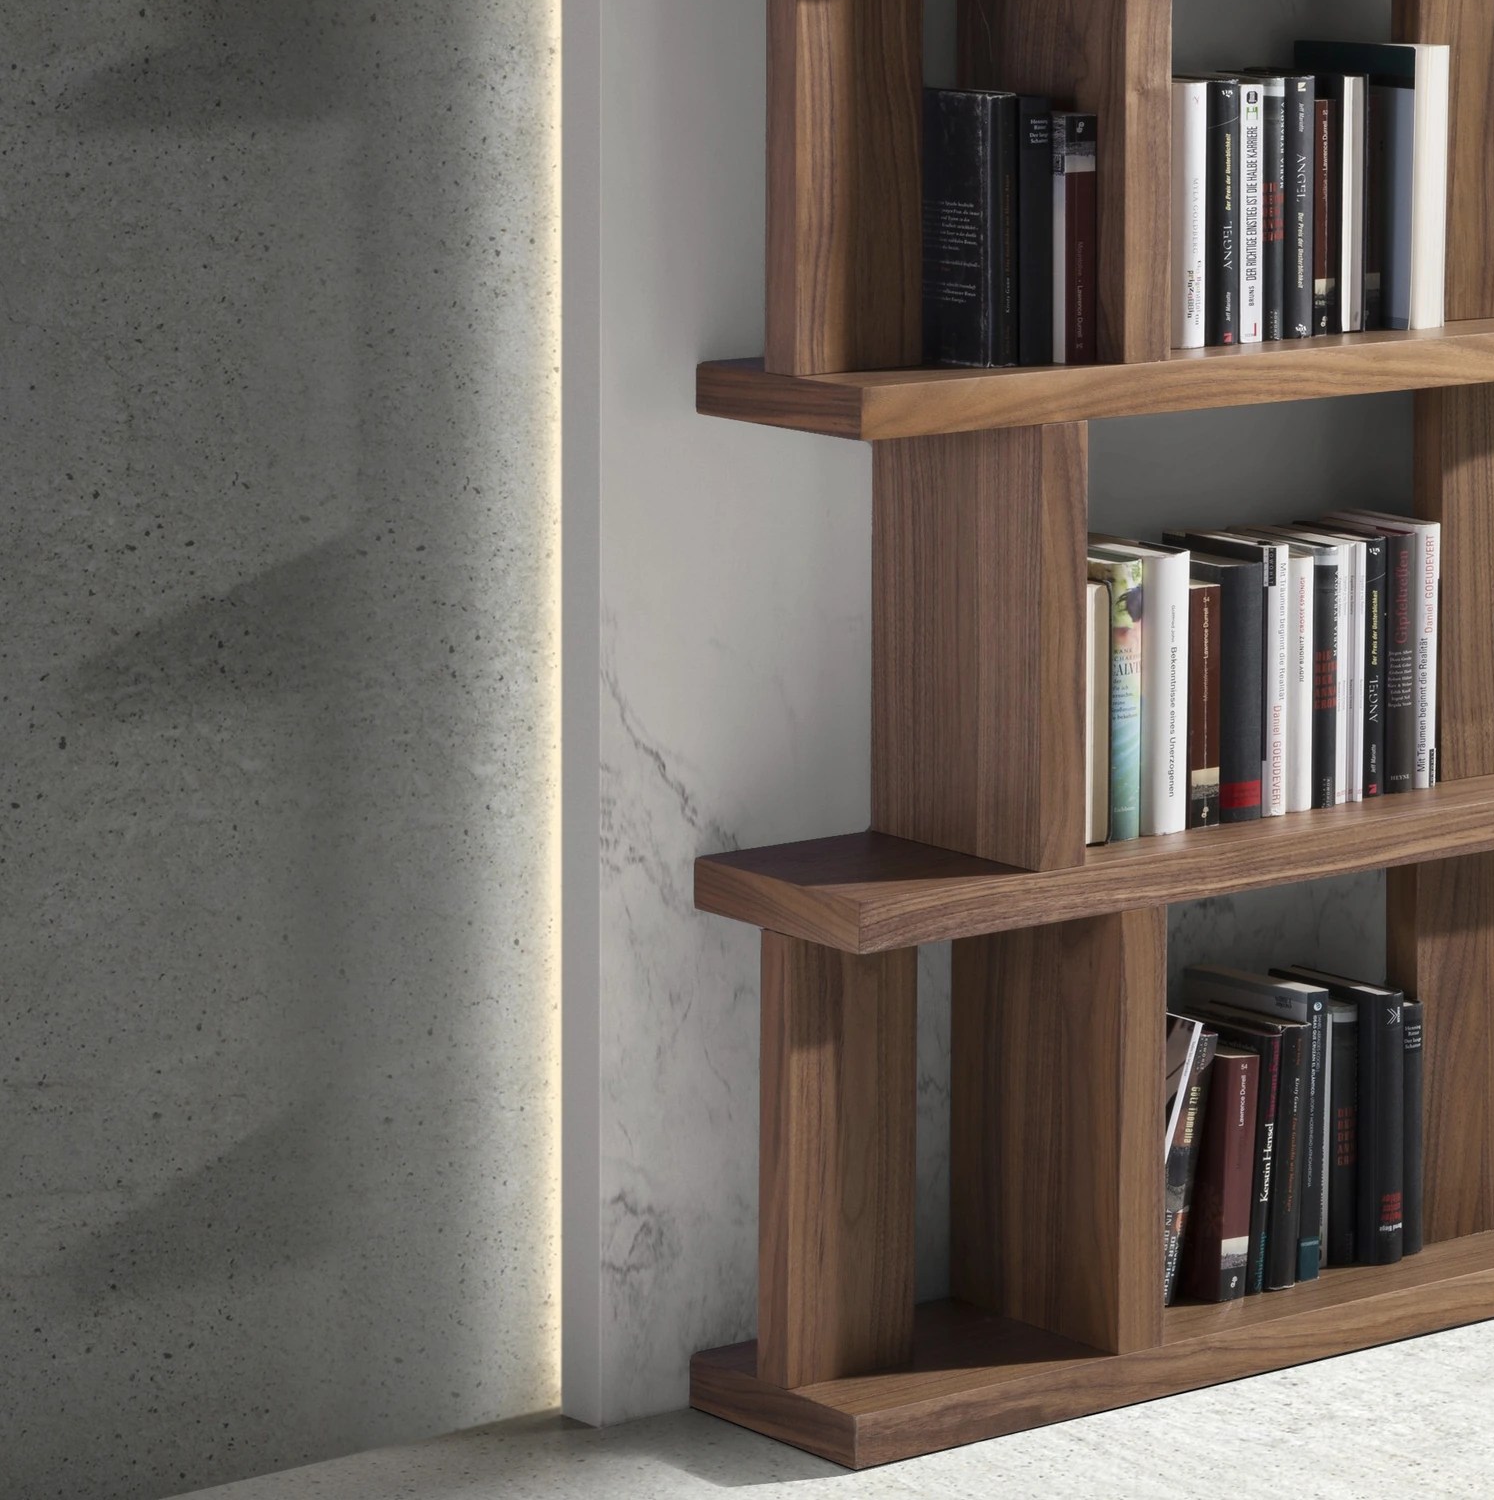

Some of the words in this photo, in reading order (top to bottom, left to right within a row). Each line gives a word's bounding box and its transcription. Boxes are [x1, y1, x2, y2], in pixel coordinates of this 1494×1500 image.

[1246, 126, 1258, 158] KARRIERE
[1246, 160, 1258, 181] HALBE
[1296, 154, 1307, 202] ANGEL
[1246, 182, 1257, 194] DIE
[1246, 194, 1257, 206] IST
[1246, 207, 1257, 236] EINSTIEG
[1224, 220, 1232, 270] ANGEL
[1246, 237, 1257, 266] RICHTIGE
[1246, 267, 1257, 280] DER
[1425, 535, 1434, 599] GOEUDEVERT
[1396, 550, 1408, 644] Gipfeltreffen
[1424, 604, 1433, 634] Daniel
[1420, 638, 1428, 670] Realität
[1369, 675, 1378, 723] ANGEL
[1420, 686, 1428, 718] beginnt
[1274, 705, 1282, 736] Daniel
[1418, 720, 1426, 756] Träumen
[1168, 737, 1176, 798] Unerzogenen
[1272, 740, 1282, 806] GOEUDEVERT
[1418, 758, 1426, 773] Mit
[1190, 1086, 1200, 1104] Götz
[1184, 1107, 1198, 1144] Thomalla
[1264, 1122, 1274, 1160] Hensel
[1260, 1162, 1270, 1203] Kerstin
[1254, 1231, 1267, 1291] Suhrkamp
